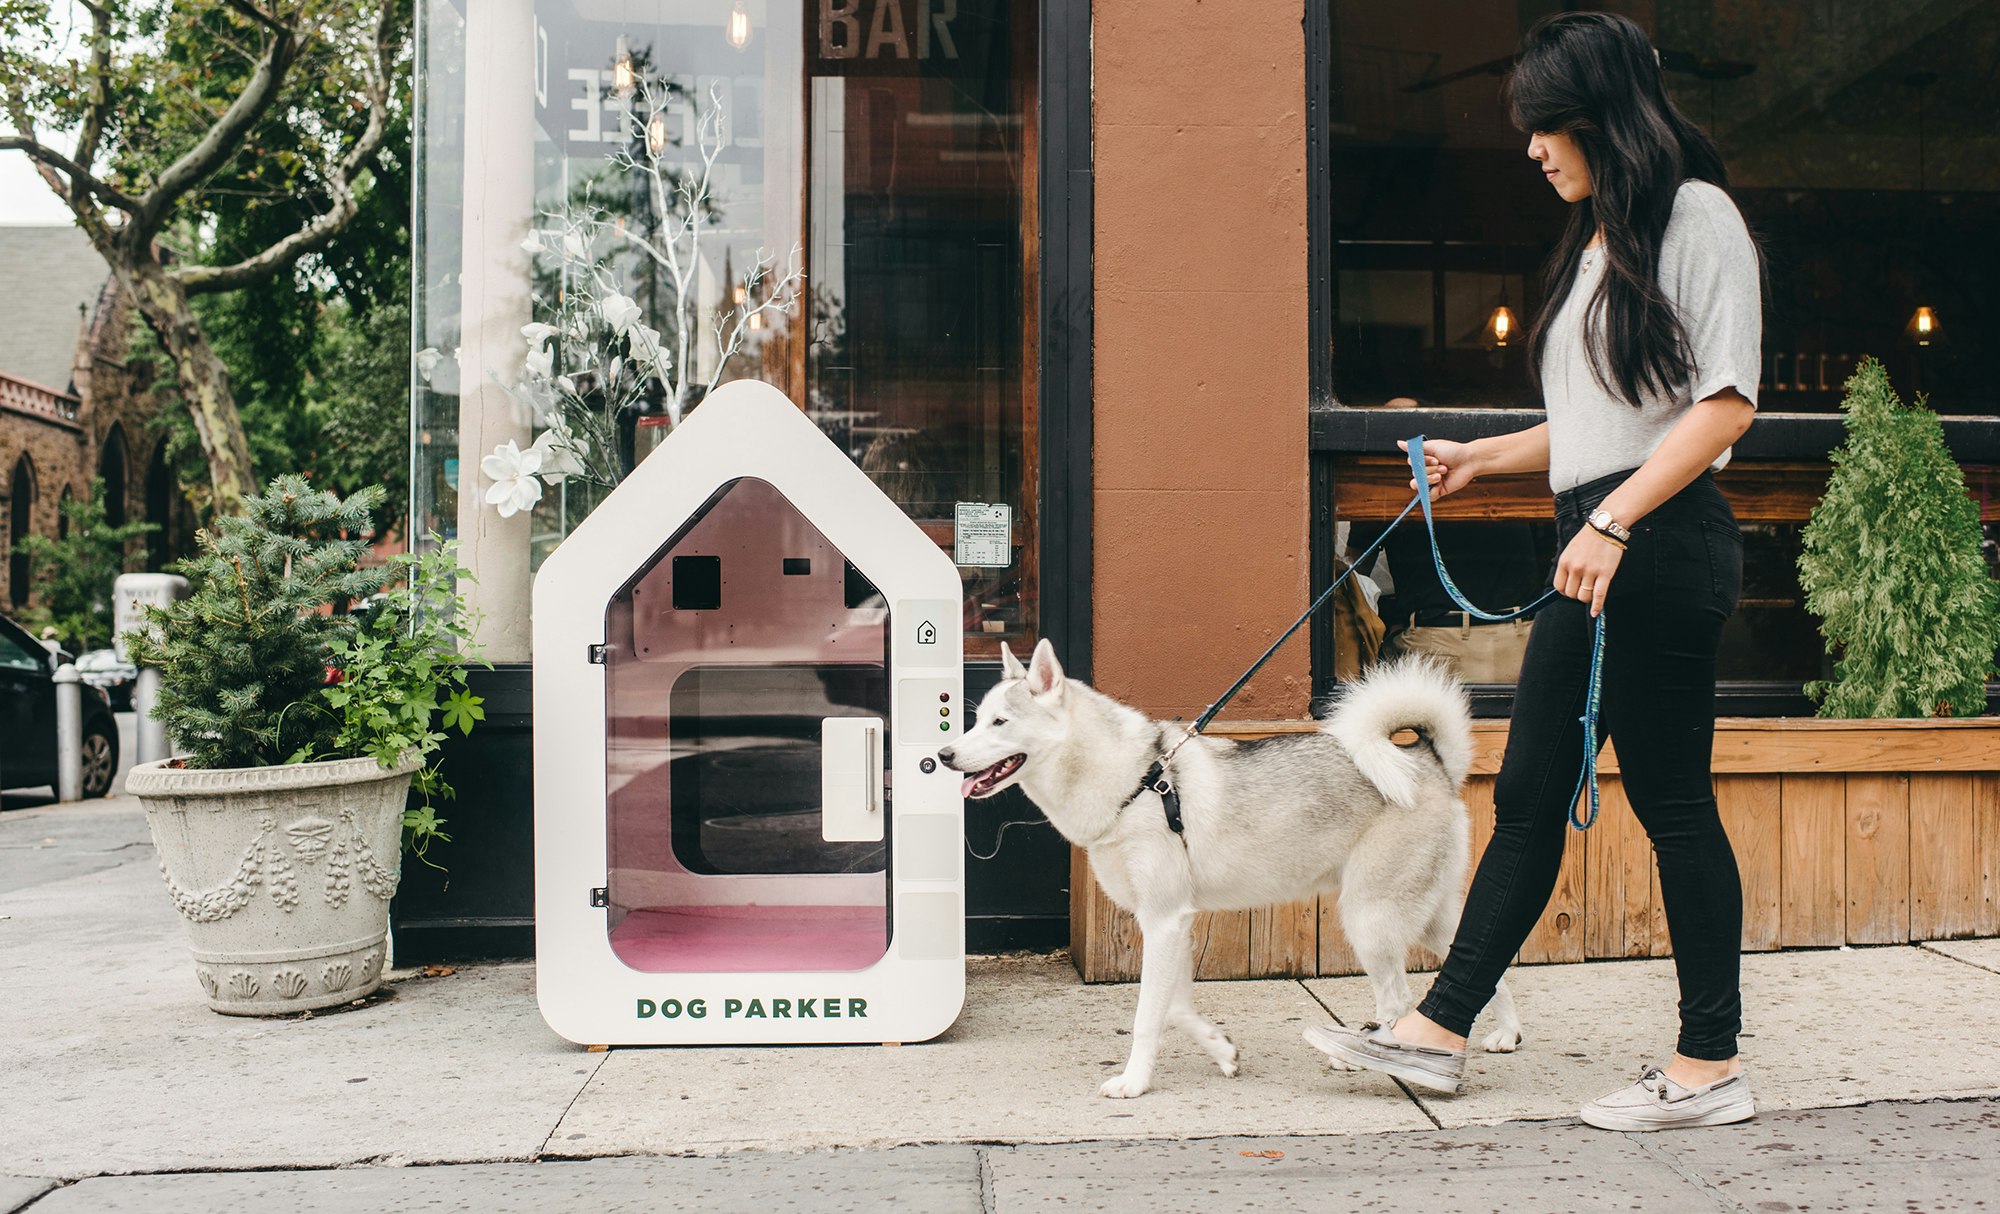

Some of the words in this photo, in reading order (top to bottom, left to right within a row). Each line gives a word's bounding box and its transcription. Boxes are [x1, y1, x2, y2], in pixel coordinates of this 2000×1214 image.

[819, 0, 959, 59] BAR
[636, 998, 707, 1019] DOG
[724, 998, 868, 1018] PARKER
